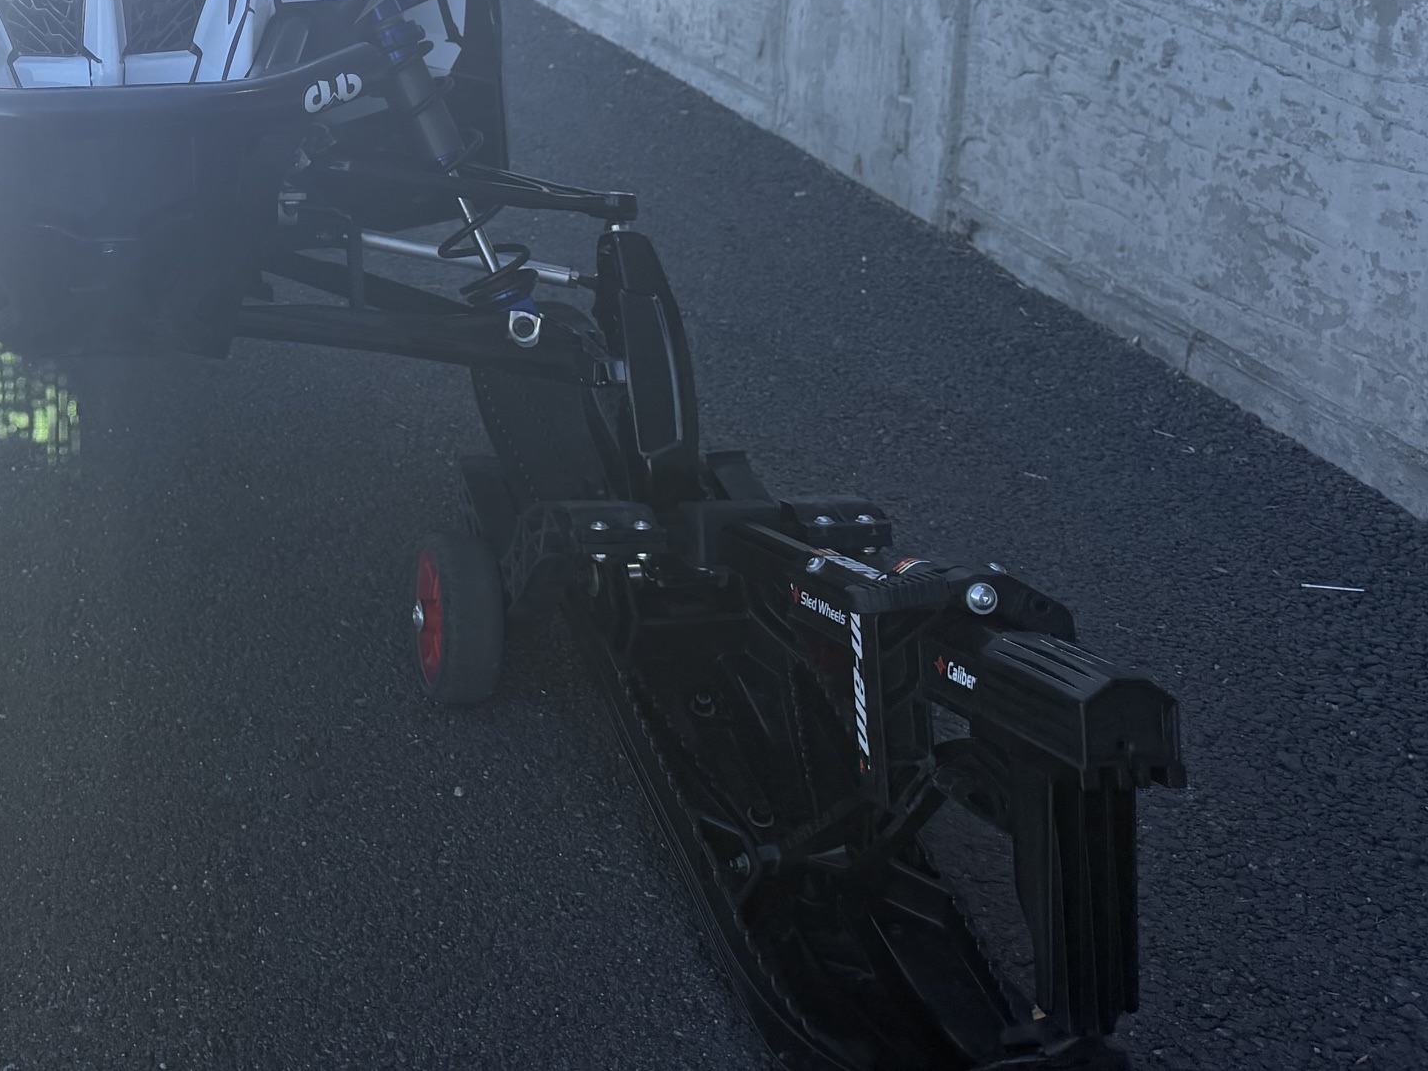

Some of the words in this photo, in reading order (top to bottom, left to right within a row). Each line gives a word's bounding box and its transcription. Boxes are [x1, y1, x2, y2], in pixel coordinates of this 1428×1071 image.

[800, 591, 817, 611] Sled
[817, 599, 846, 626] Wheels
[947, 661, 977, 690] Caliber
